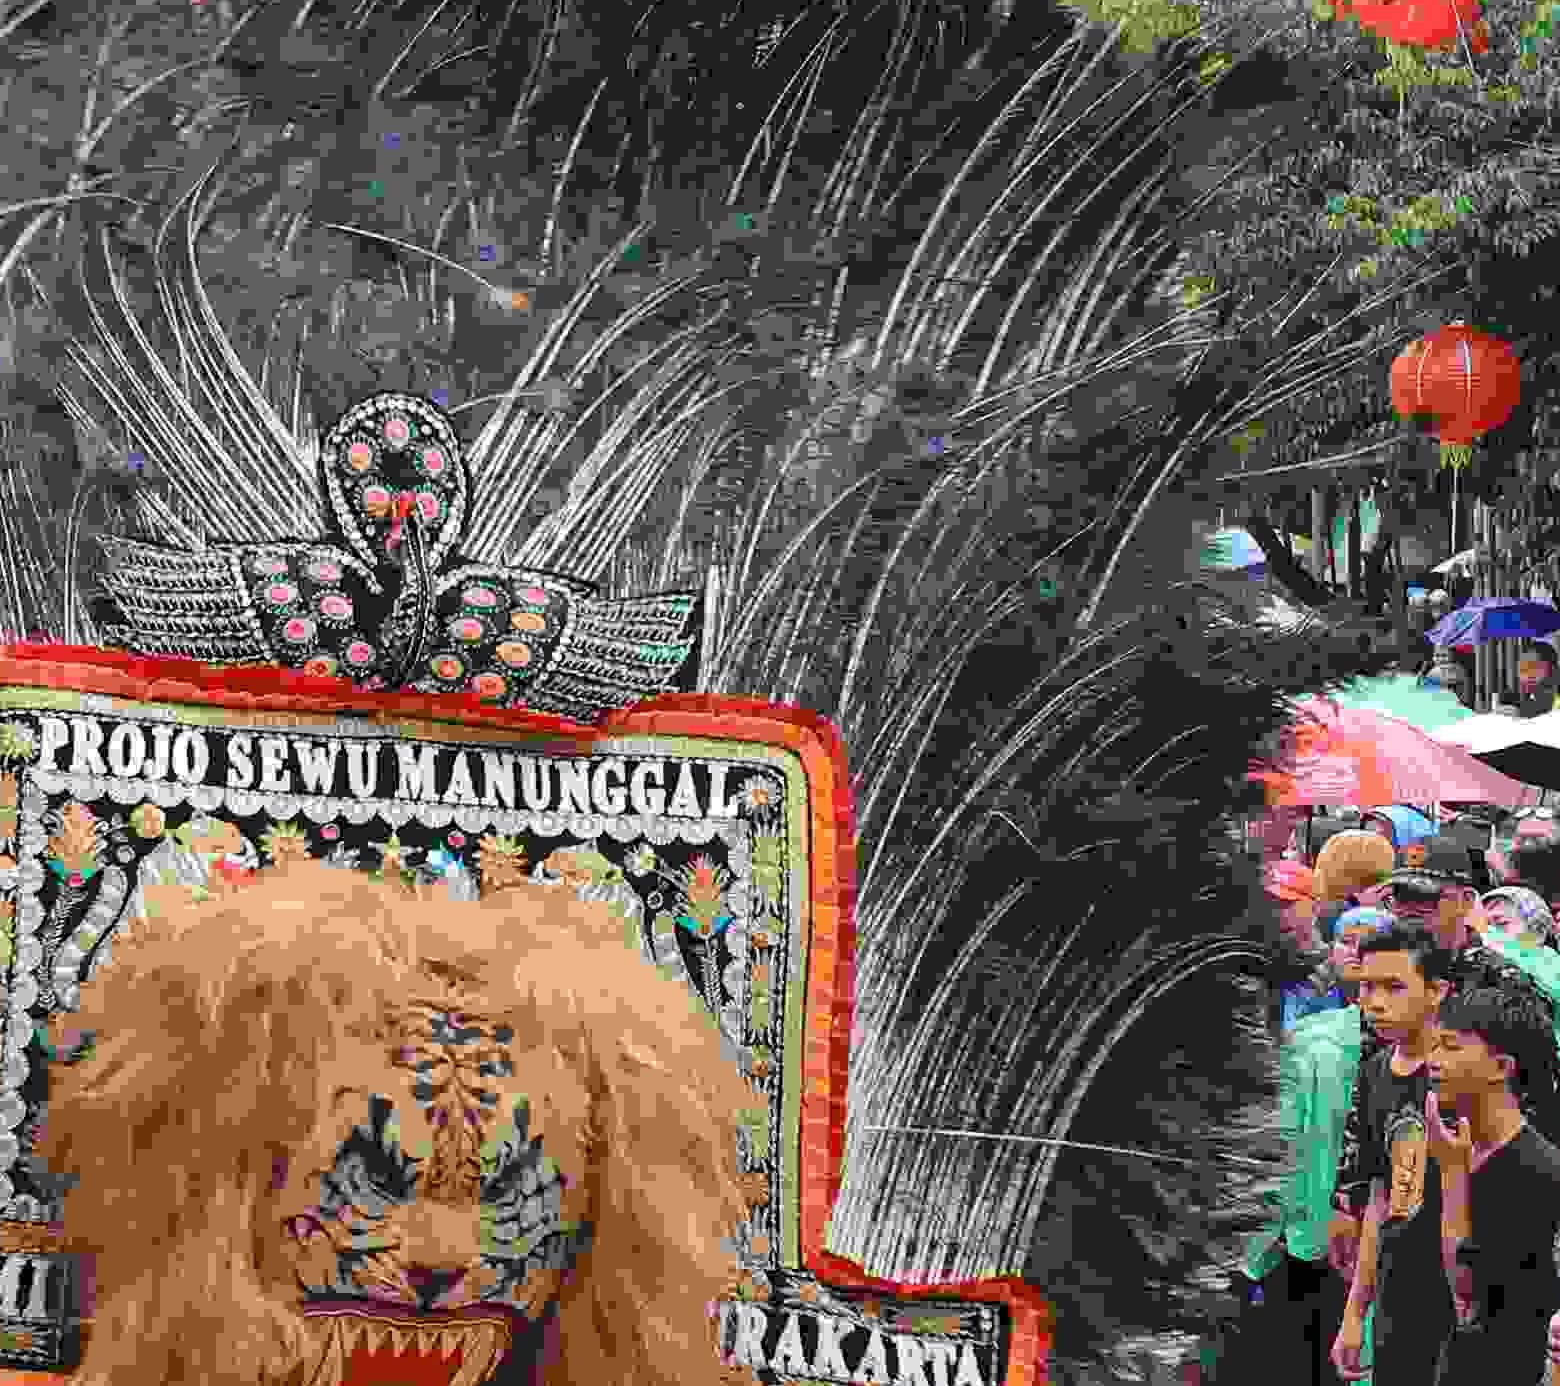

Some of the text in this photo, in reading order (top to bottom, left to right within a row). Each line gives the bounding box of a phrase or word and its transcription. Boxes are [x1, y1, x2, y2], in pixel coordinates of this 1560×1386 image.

[34, 715, 740, 818] PROJO SEWU MANUNGGAL
